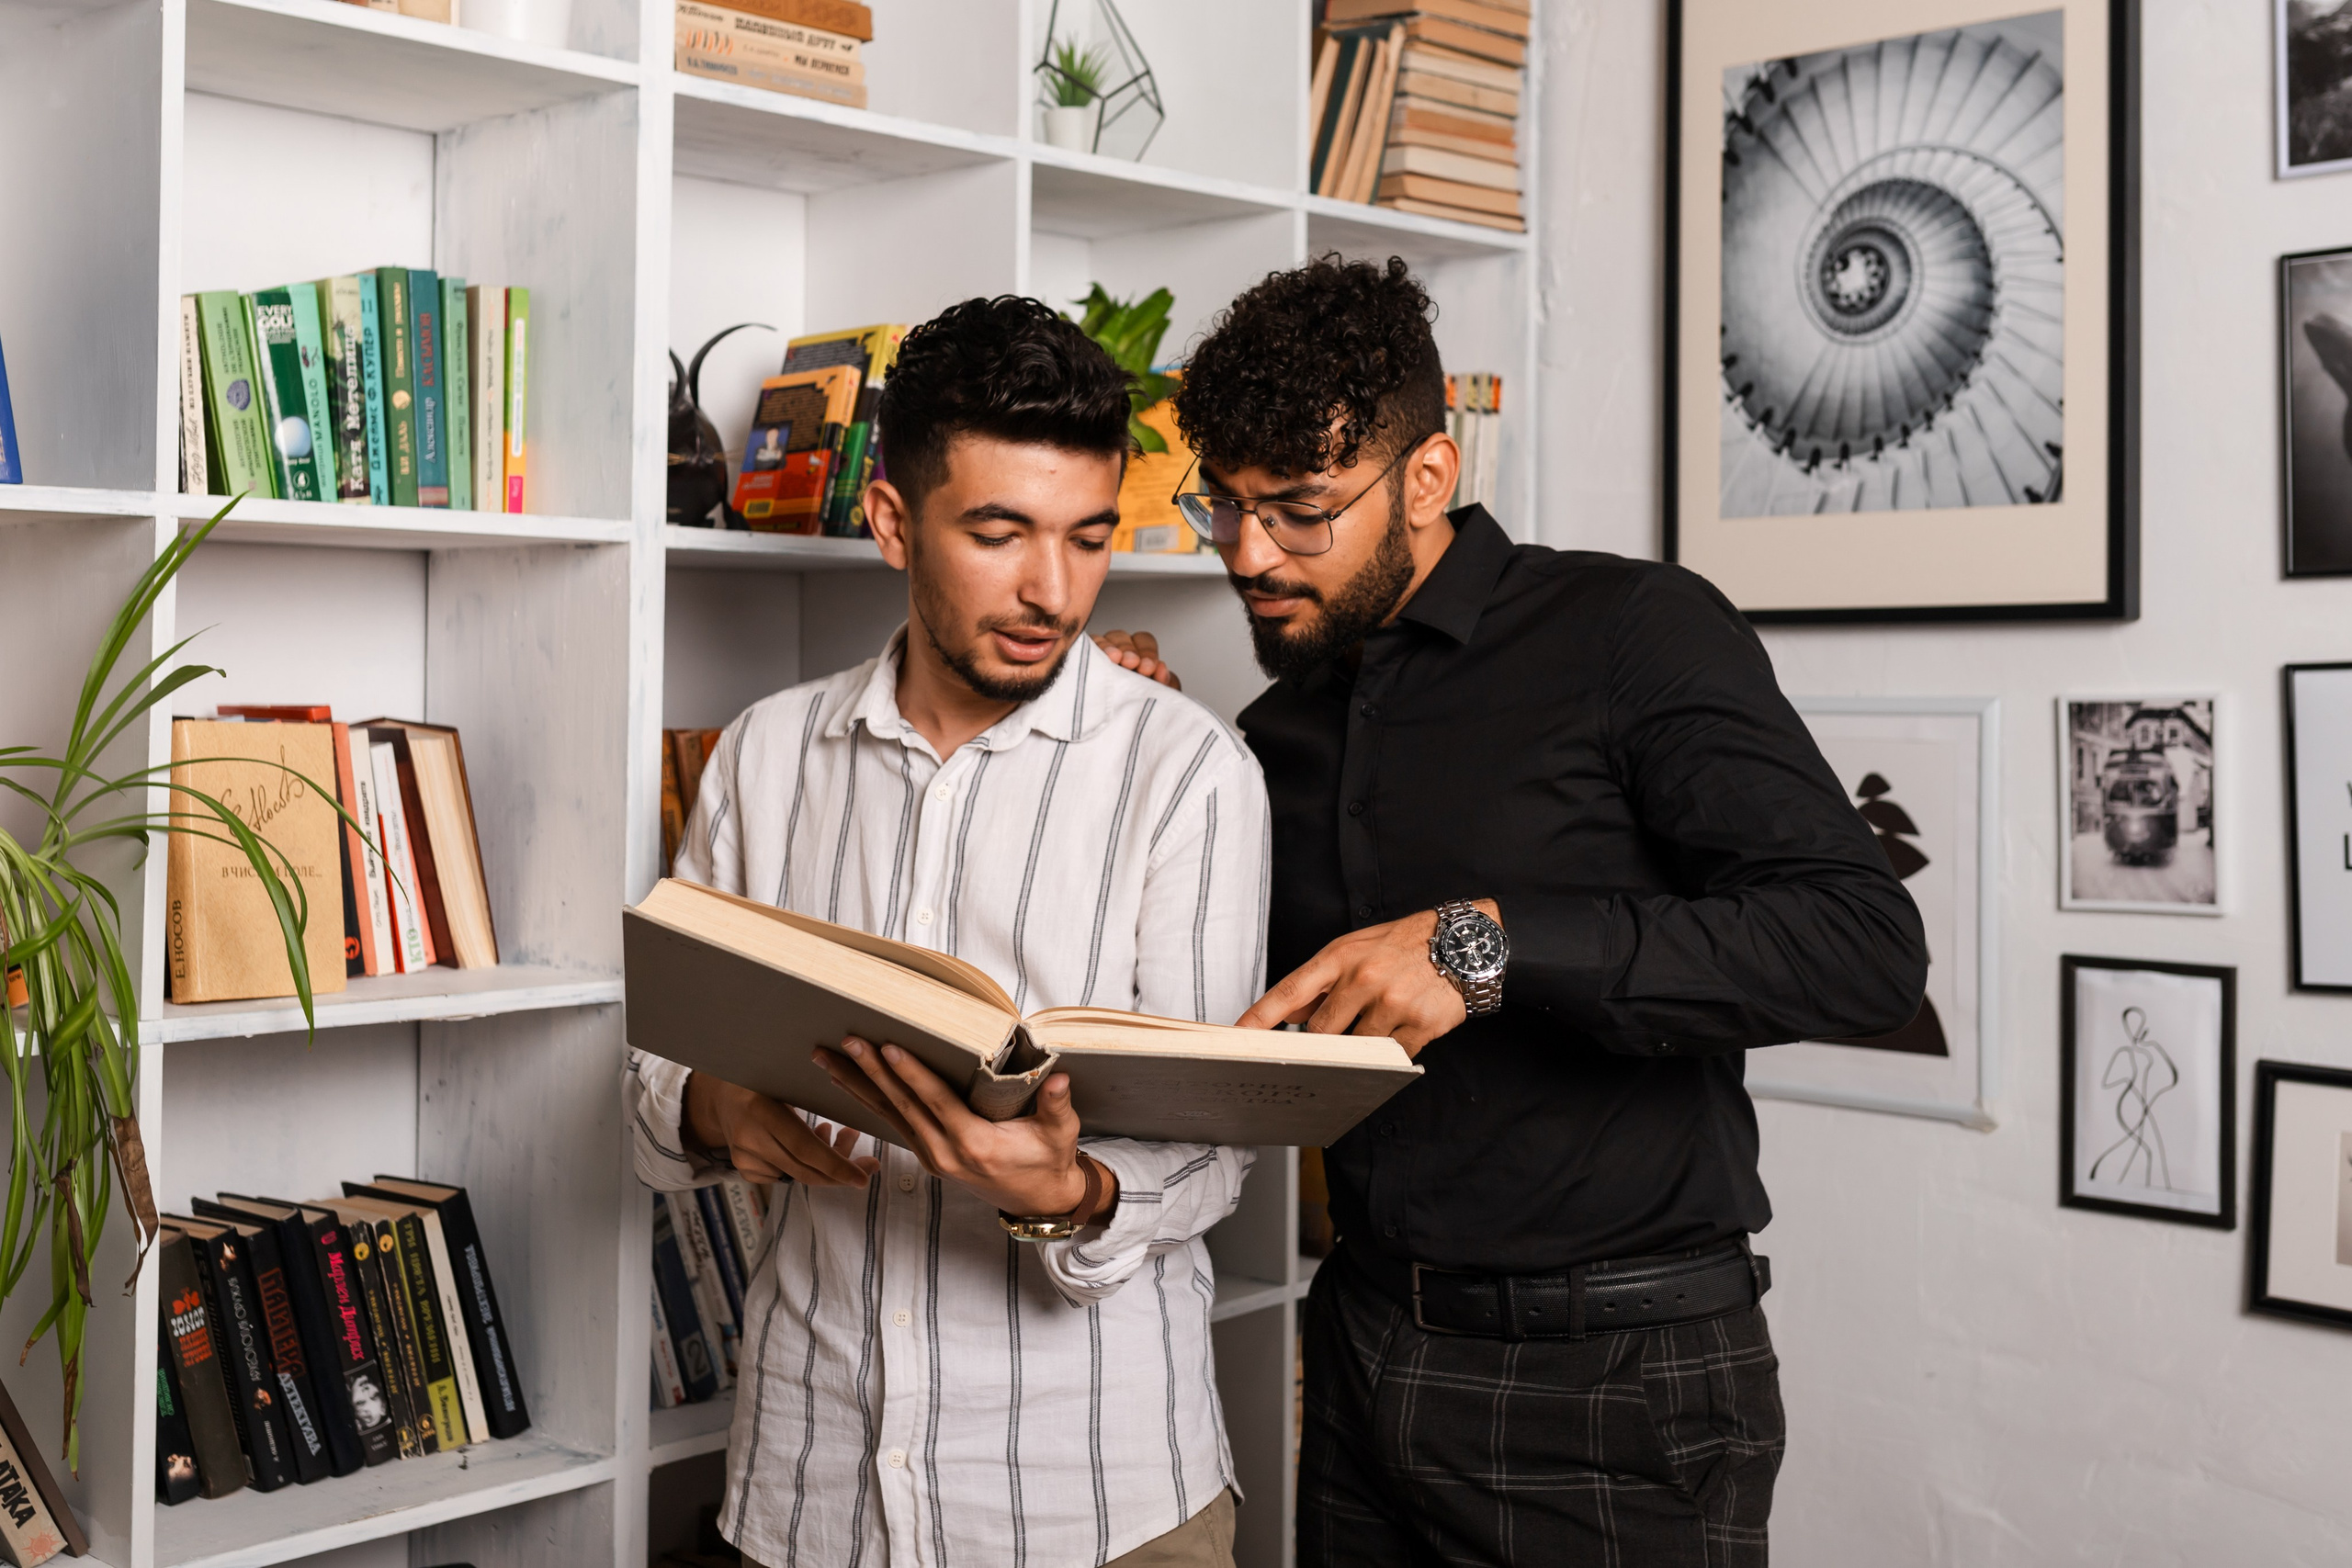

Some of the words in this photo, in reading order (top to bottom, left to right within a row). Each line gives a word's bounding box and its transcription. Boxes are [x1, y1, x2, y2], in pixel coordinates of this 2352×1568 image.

[418, 312, 434, 388] КАСЫМОВ
[309, 378, 323, 442] MANOLO
[367, 405, 381, 471] Джеймс
[421, 396, 438, 463] Александр
[350, 440, 365, 491] Катя
[221, 866, 229, 878] В
[231, 866, 280, 878] ЧИС
[258, 1268, 306, 1380] МАСТЕРА
[327, 1251, 349, 1304] Марлен
[339, 1303, 364, 1360] Дитрих
[404, 1222, 415, 1247] ТРИ
[421, 1299, 439, 1363] ВРЕМЕНИ
[687, 1339, 707, 1375] 2
[278, 1373, 321, 1456] ДЕТЕКТИВА
